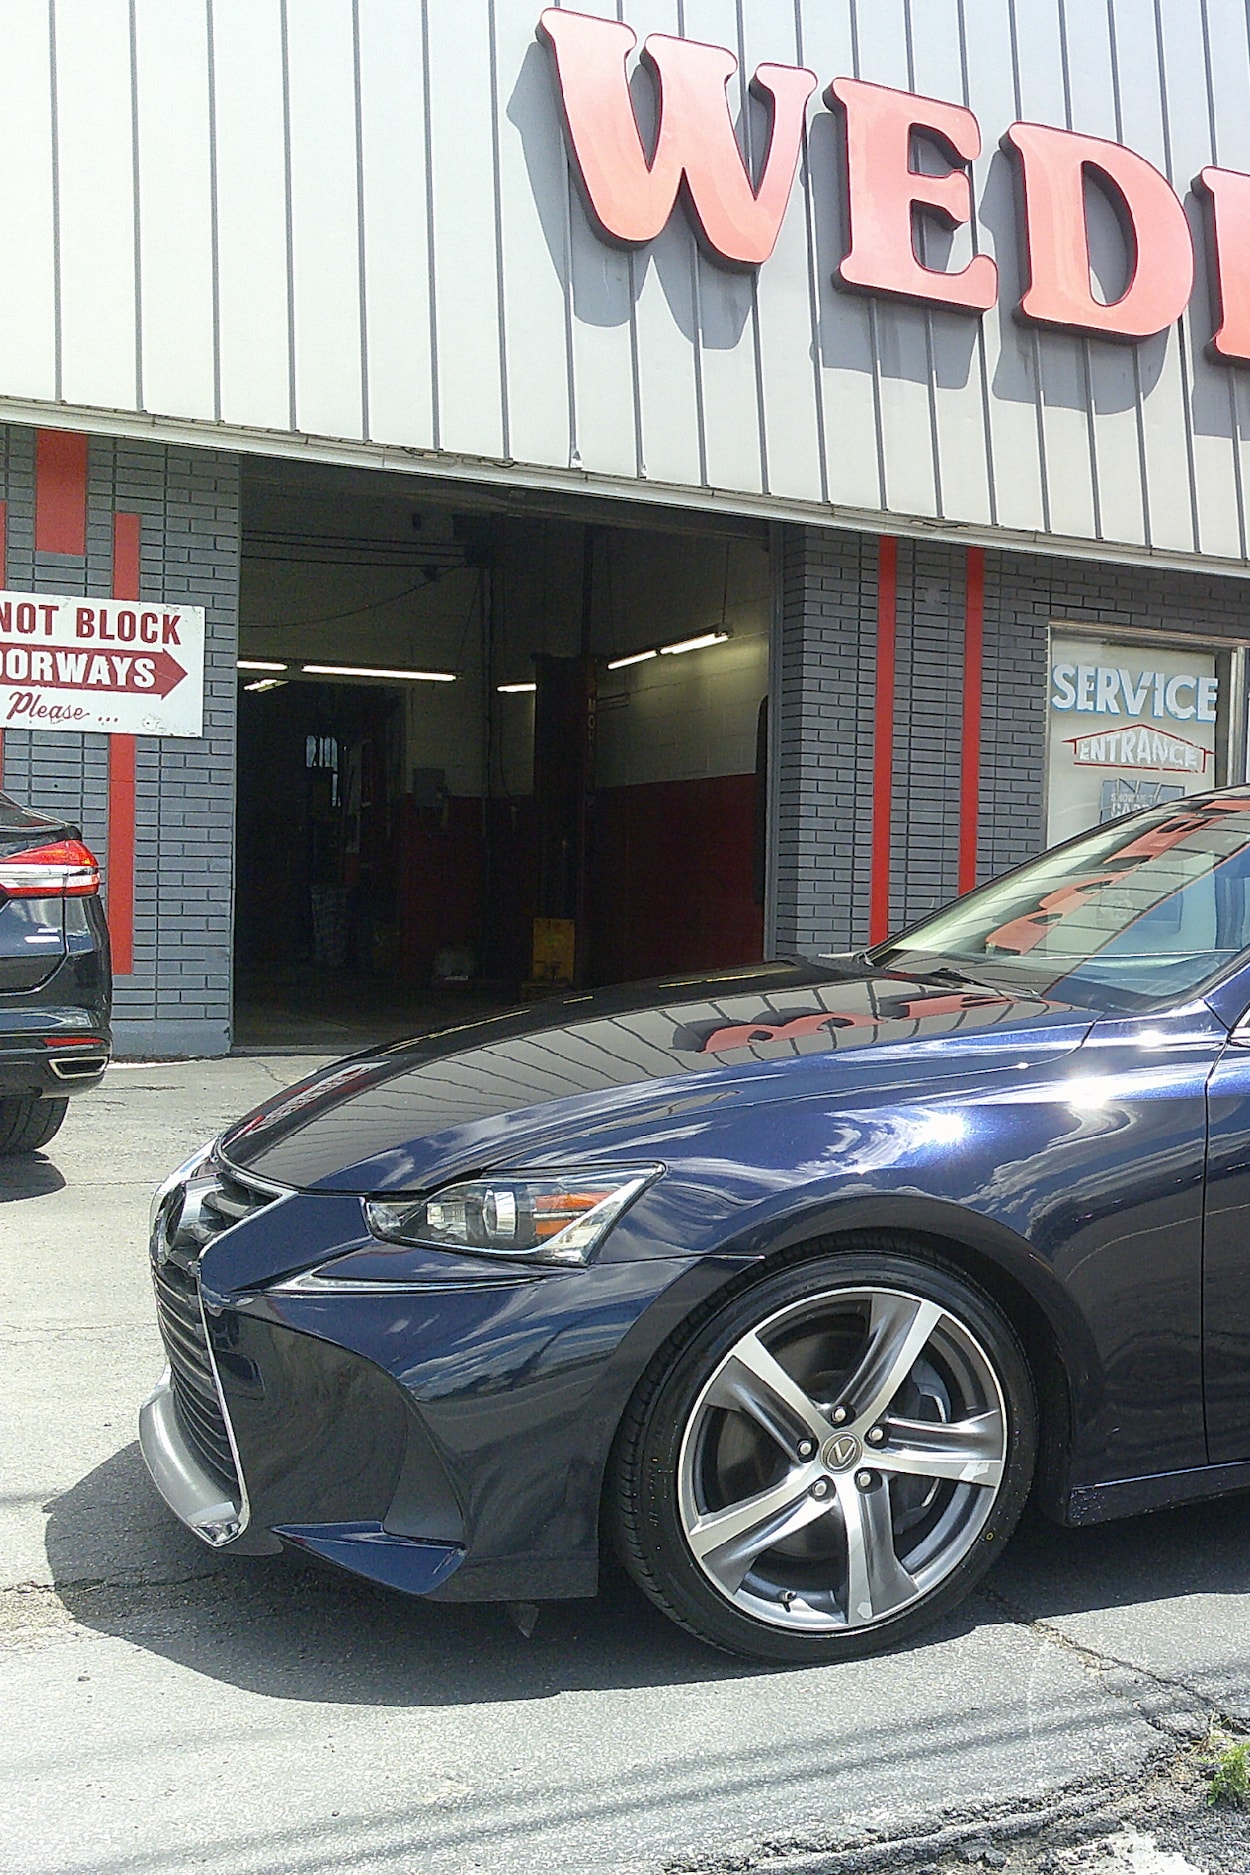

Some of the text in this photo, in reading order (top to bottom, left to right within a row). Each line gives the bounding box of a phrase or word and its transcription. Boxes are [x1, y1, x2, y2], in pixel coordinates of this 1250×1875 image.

[76, 608, 182, 645] BLOCK
[0, 648, 156, 688] ORWAYS
[6, 691, 91, 720] Please
[1051, 664, 1219, 723] SERVICE
[1079, 728, 1198, 767] ENTRANCE
